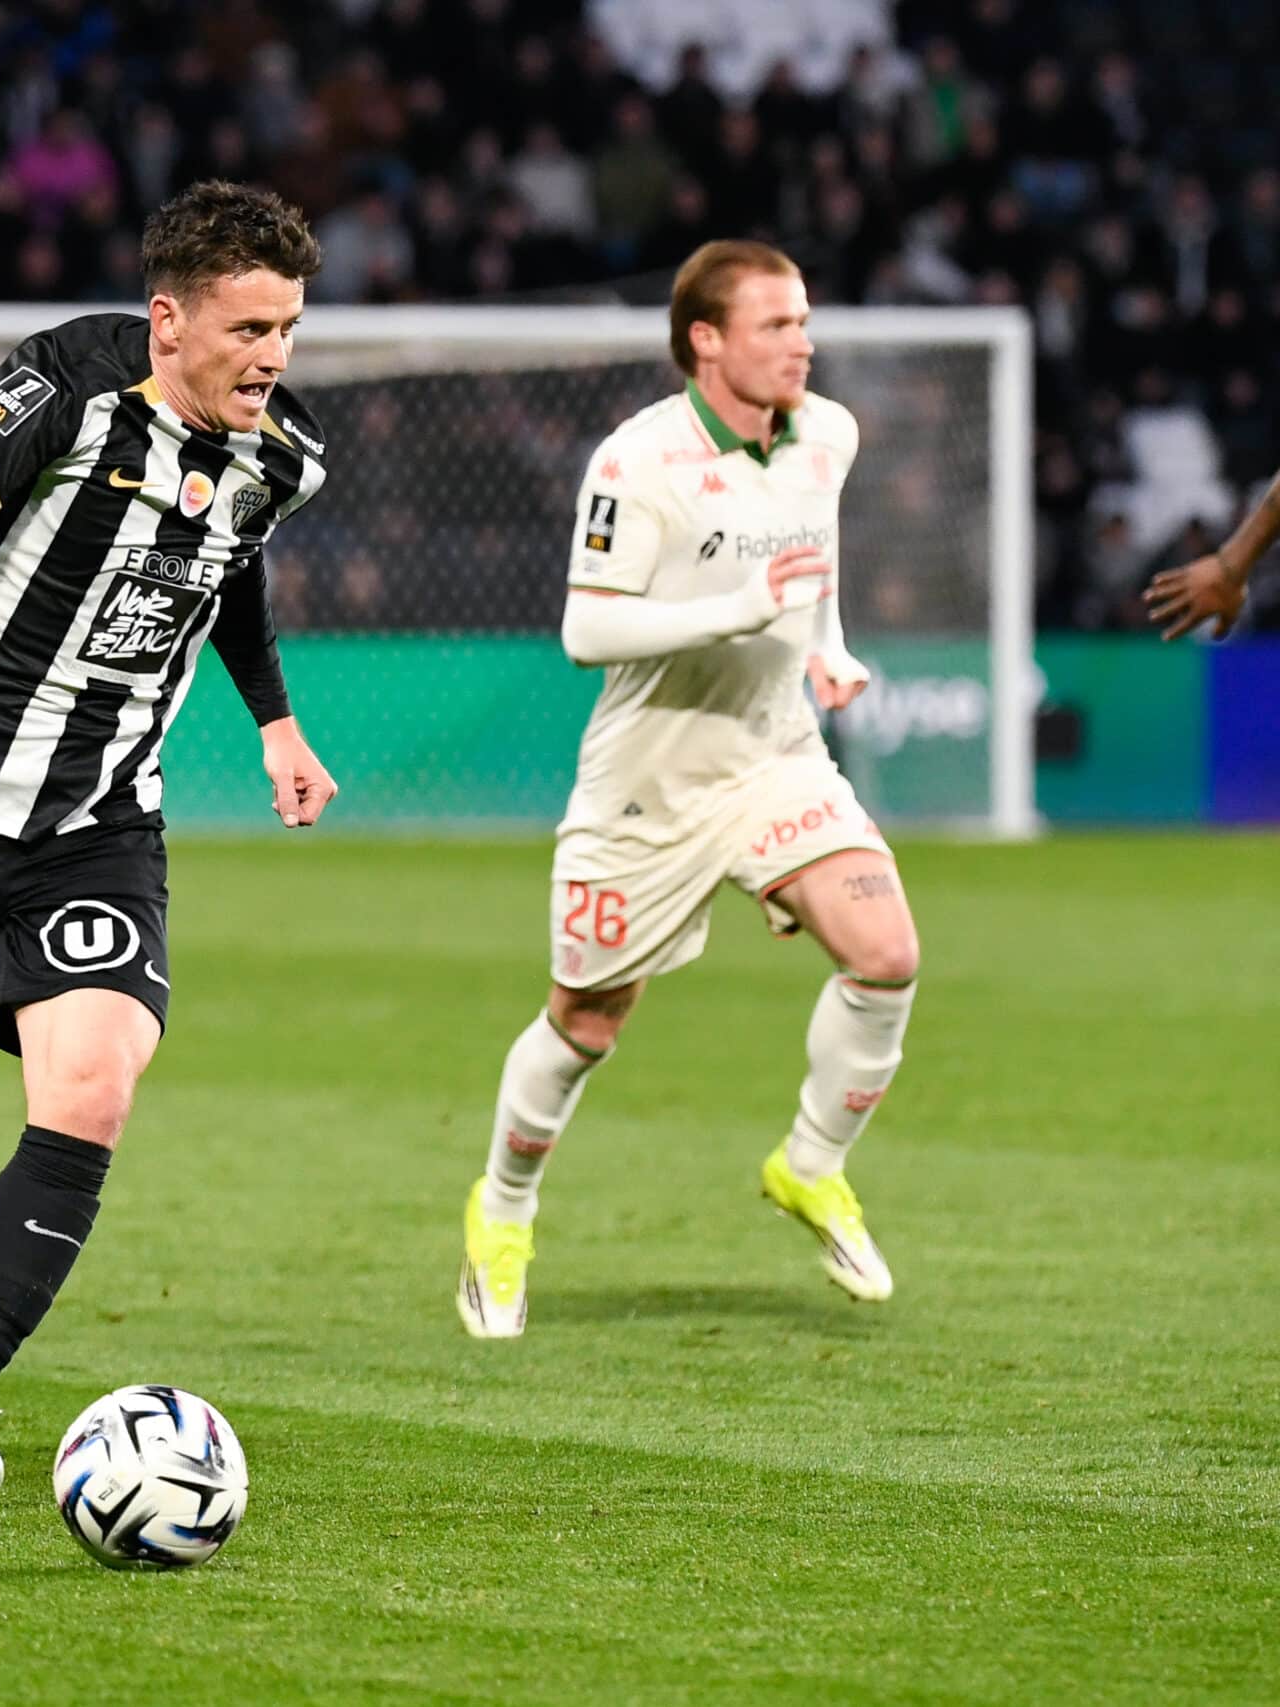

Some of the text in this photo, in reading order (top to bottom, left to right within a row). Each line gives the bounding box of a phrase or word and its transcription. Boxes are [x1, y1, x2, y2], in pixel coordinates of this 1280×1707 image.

[237, 489, 265, 506] SCO
[126, 548, 215, 586] ECOLE
[751, 800, 843, 856] vbet
[564, 880, 628, 949] 26
[64, 917, 114, 960] U
